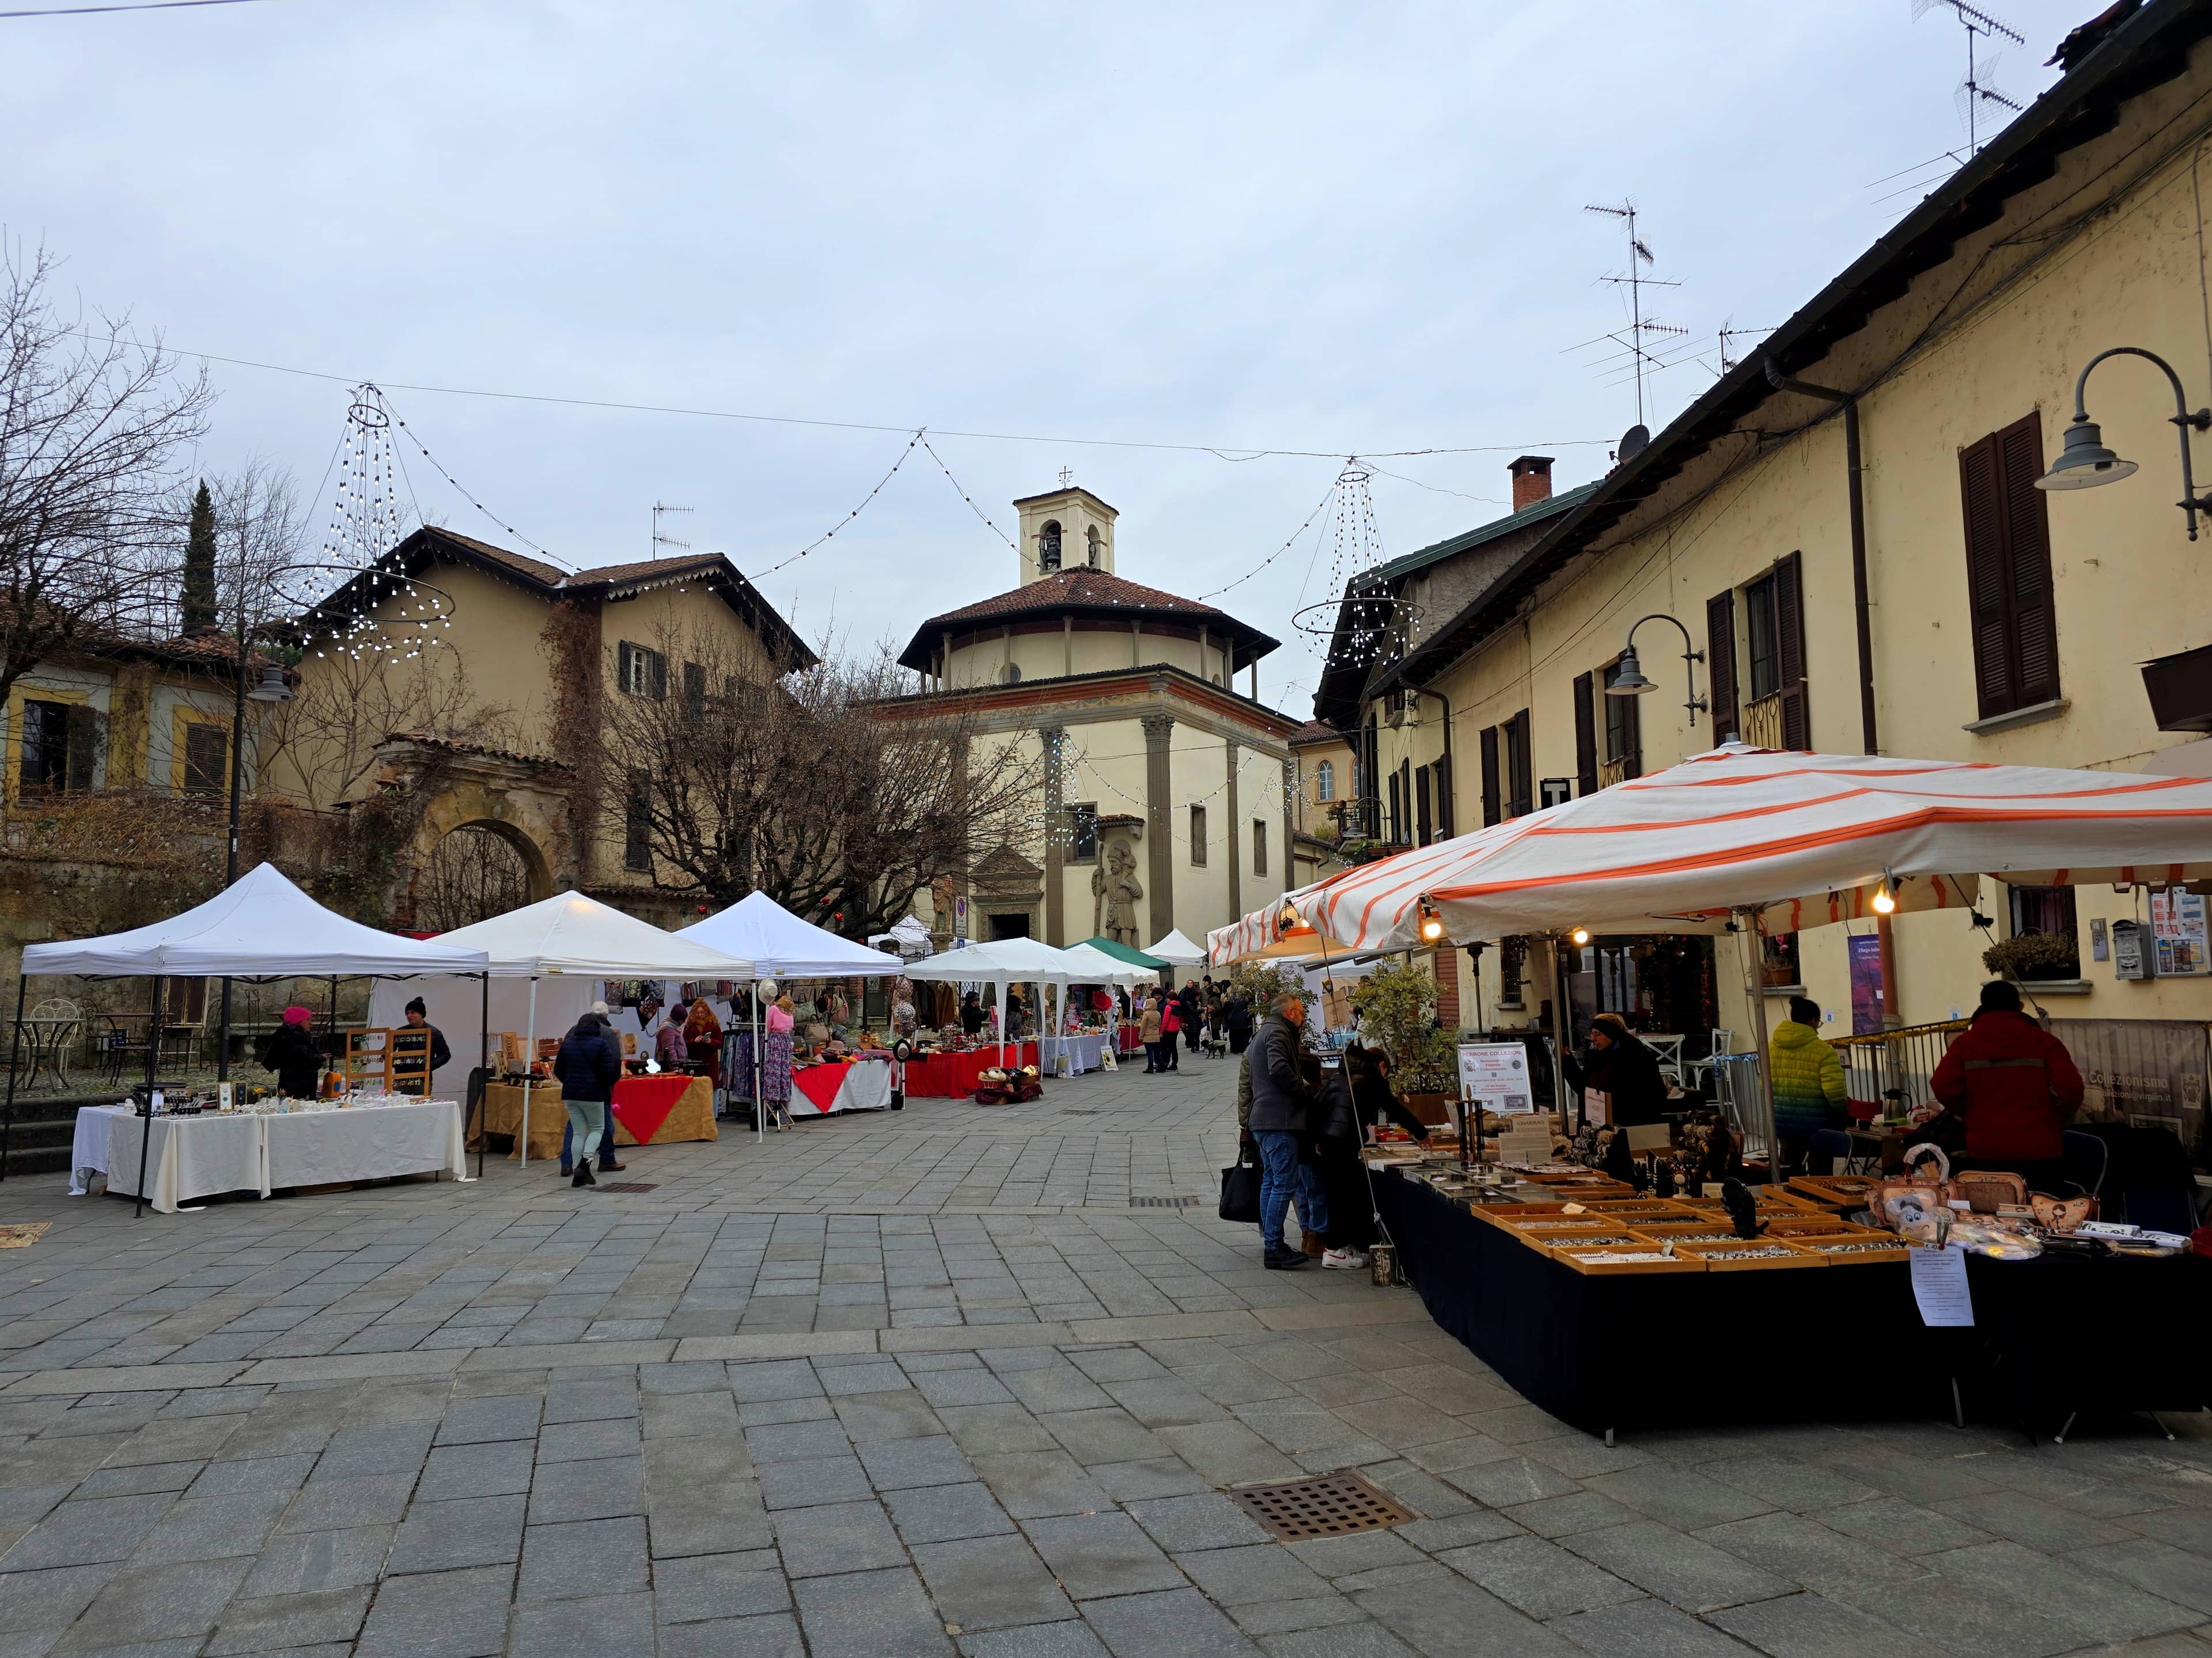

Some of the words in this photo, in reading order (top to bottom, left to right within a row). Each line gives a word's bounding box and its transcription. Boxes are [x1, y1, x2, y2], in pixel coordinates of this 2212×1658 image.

[1544, 783, 1567, 806] T
[2096, 938, 2100, 946] 2
[2089, 1072, 2168, 1088] Collezionismo
